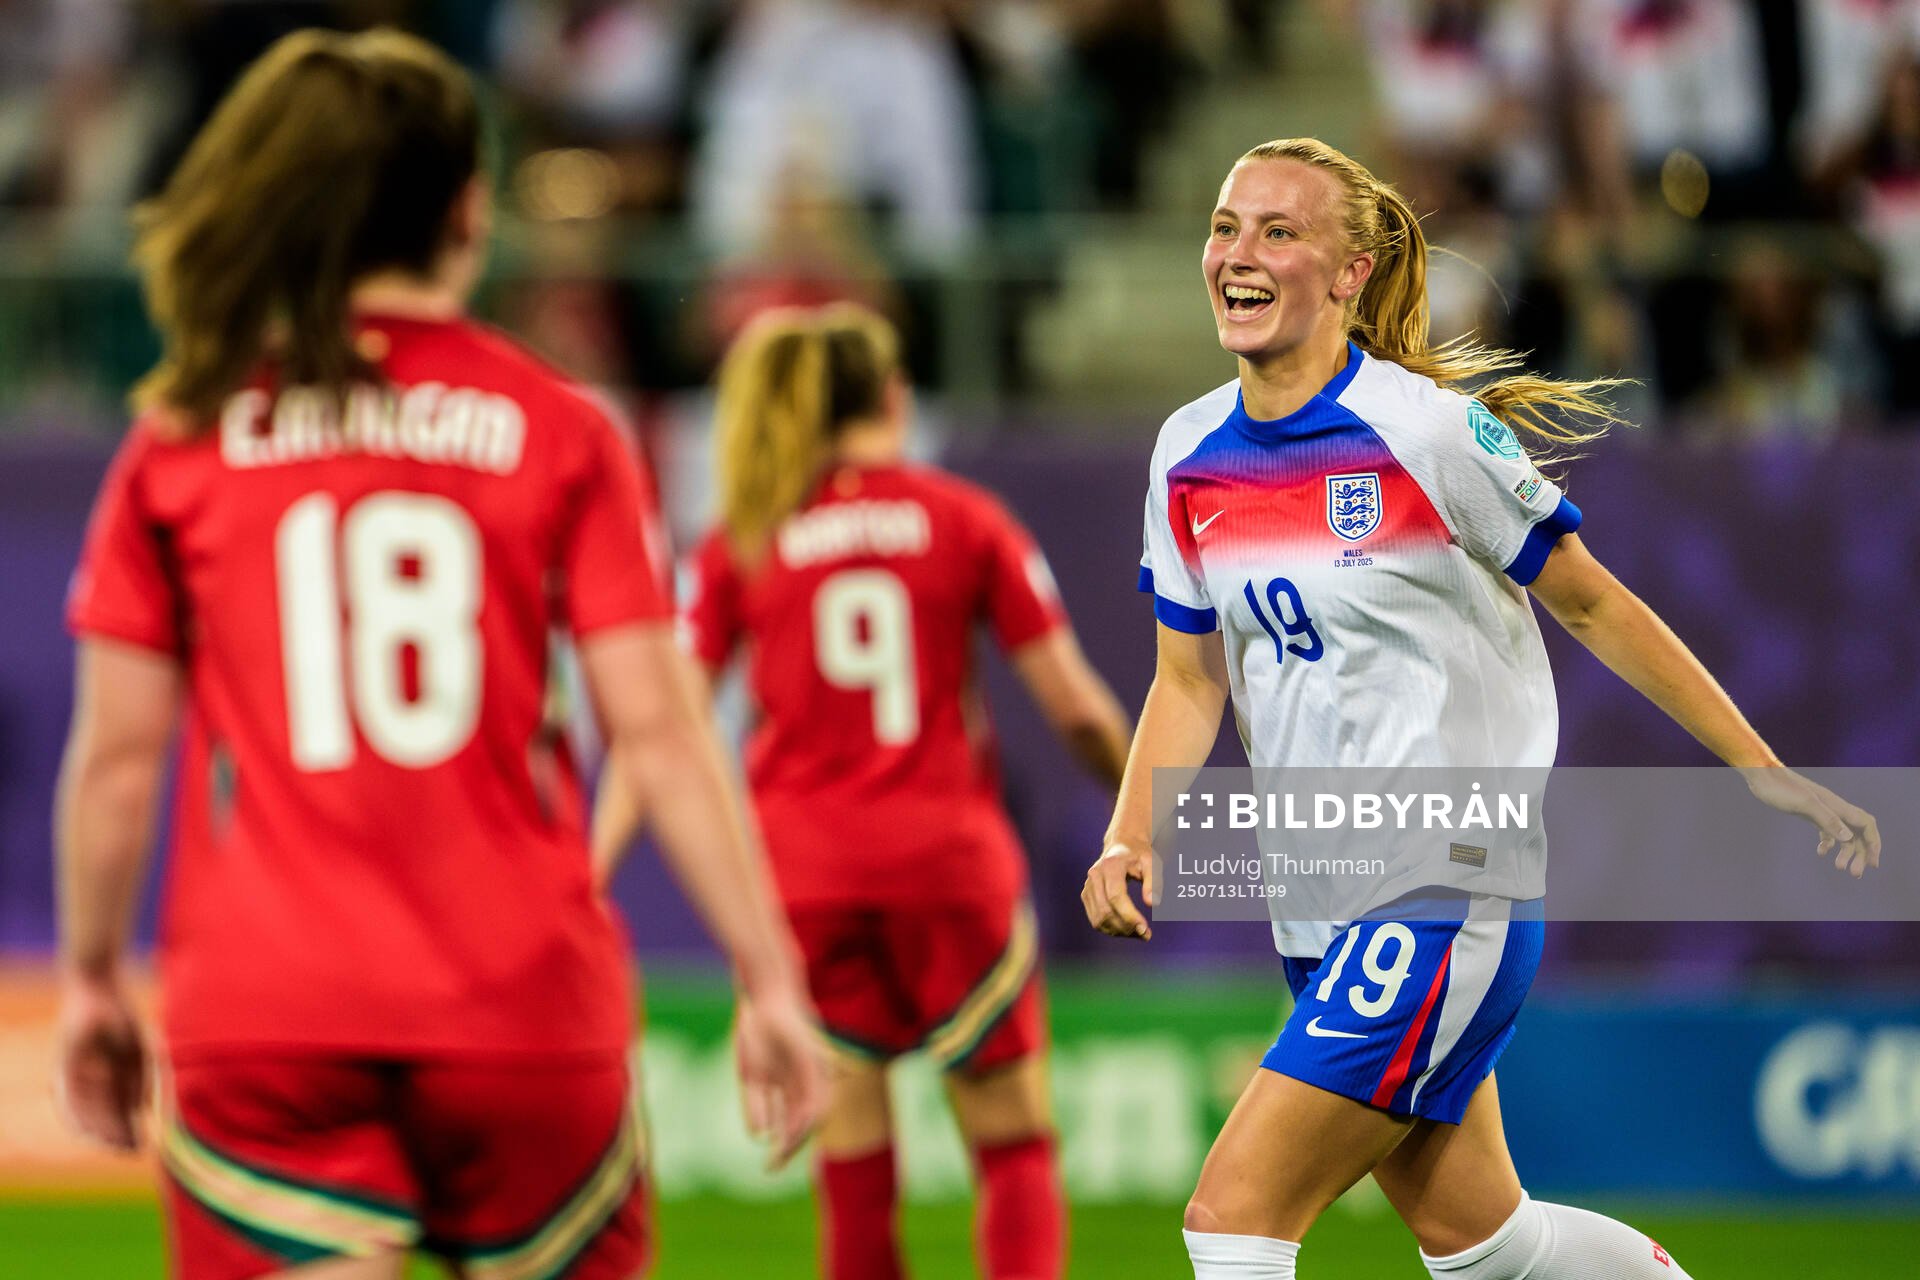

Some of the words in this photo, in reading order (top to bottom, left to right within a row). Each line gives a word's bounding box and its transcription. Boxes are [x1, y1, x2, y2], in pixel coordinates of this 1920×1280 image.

[1334, 559, 1341, 568] 13
[1342, 558, 1356, 567] JULY
[1357, 557, 1374, 566] 2025
[1343, 549, 1363, 557] WALES
[274, 489, 487, 773] 18
[811, 566, 921, 748] 9
[1243, 577, 1324, 664] 19
[1315, 922, 1416, 1017] 19
